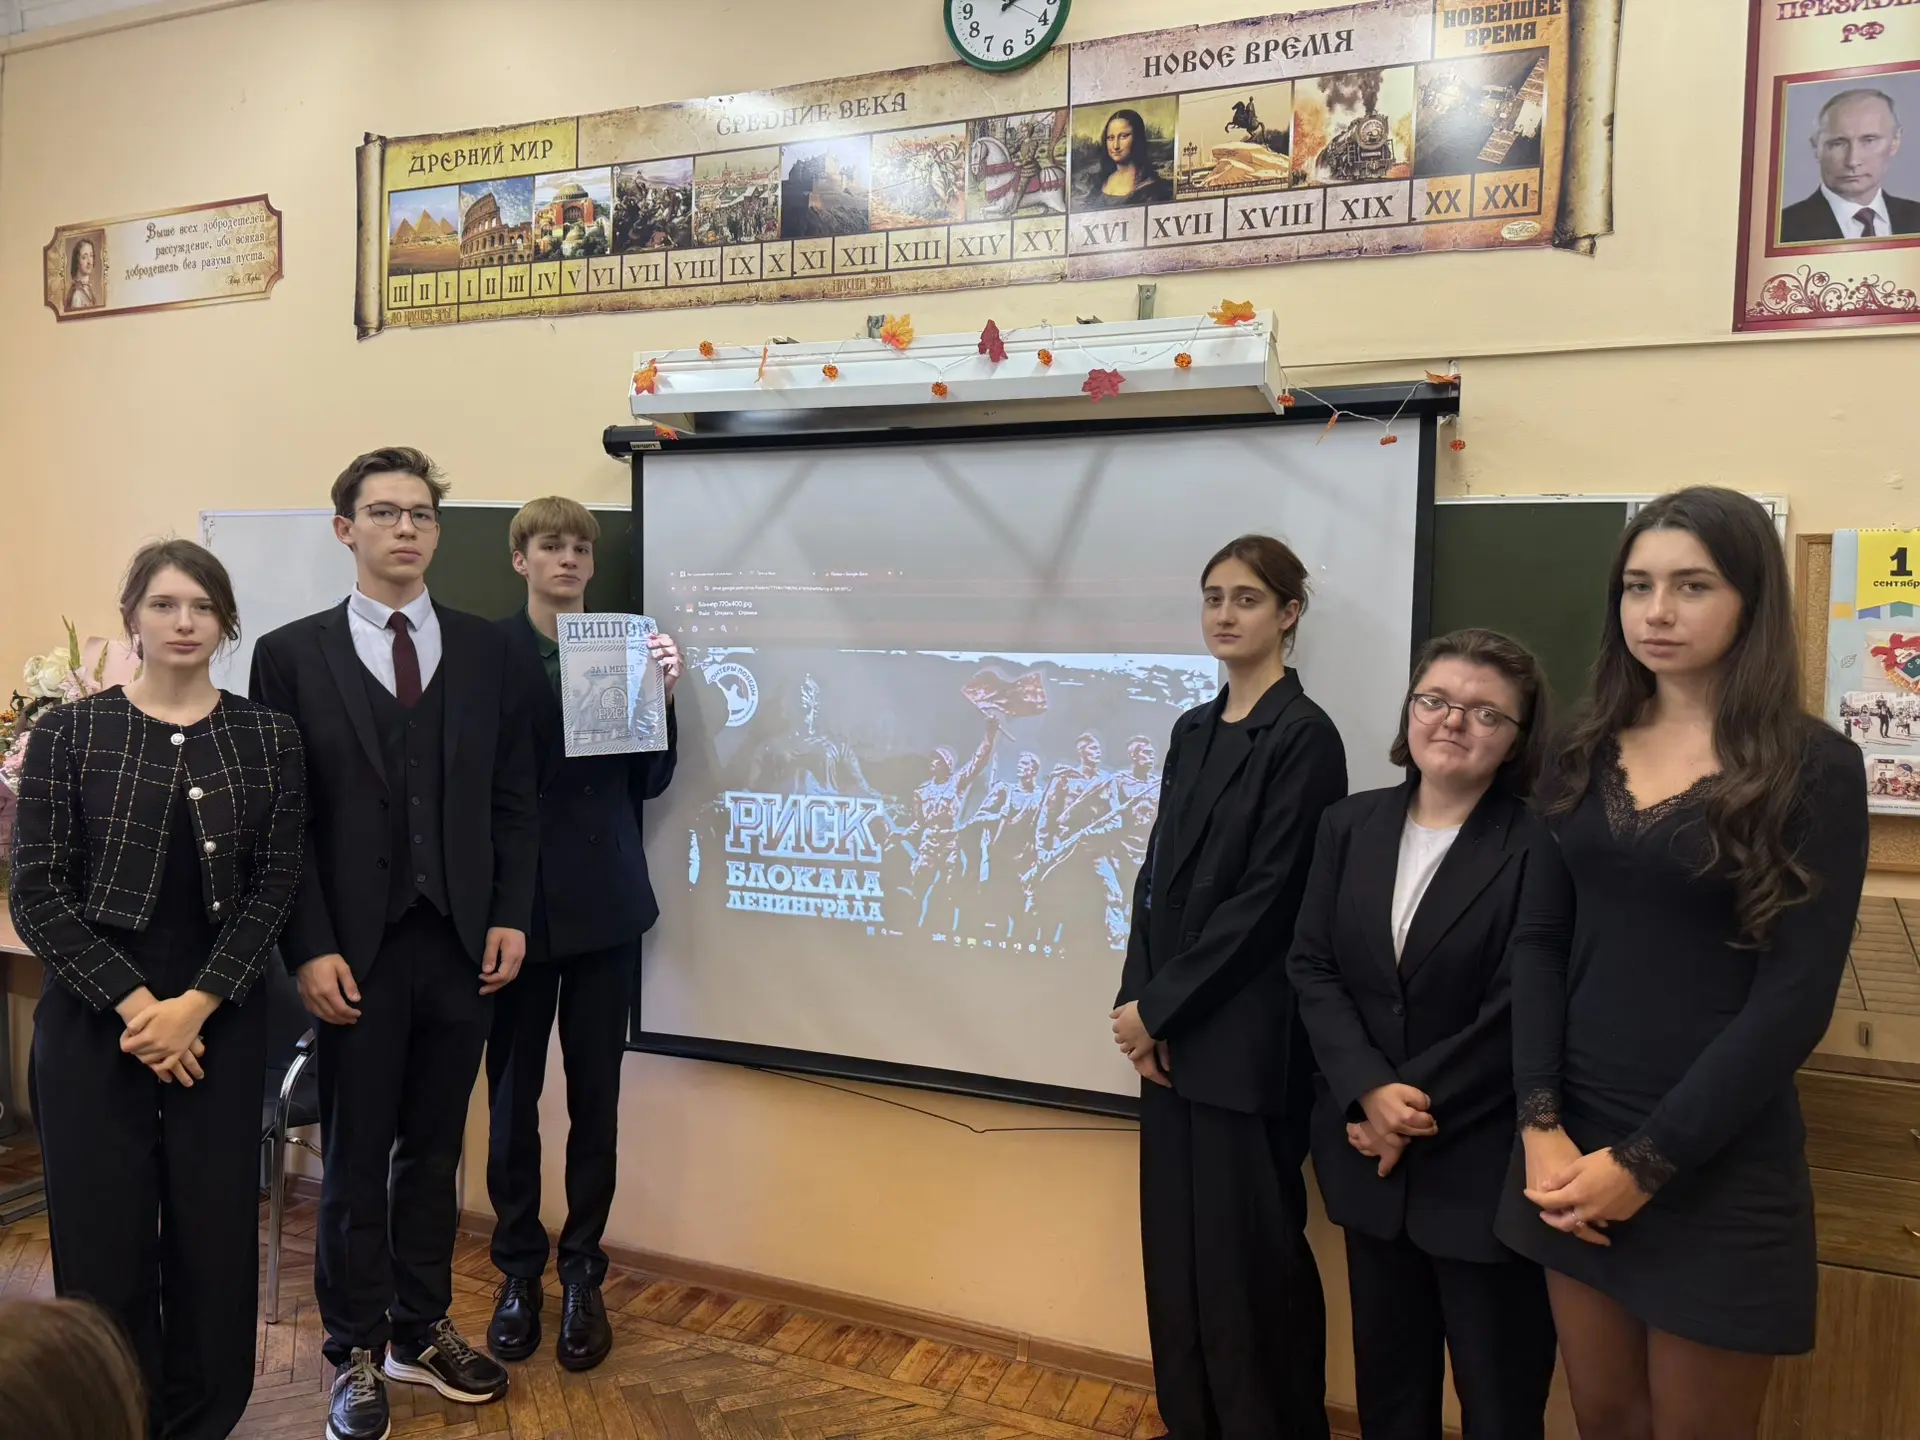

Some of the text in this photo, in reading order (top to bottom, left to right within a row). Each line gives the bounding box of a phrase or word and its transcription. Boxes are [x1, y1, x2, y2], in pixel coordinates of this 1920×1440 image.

[962, 3, 973, 20] 9
[1038, 8, 1049, 26] 4
[969, 21, 980, 38] 8
[1024, 28, 1035, 46] 5
[1465, 21, 1537, 47] ВРЕМЯ
[1840, 21, 1885, 43] РФ
[984, 35, 994, 53] 7
[1003, 39, 1014, 56] 6
[1142, 29, 1354, 78] НОВОЕ ВРЕМЯ
[838, 92, 908, 120] ВЕКА
[408, 139, 554, 177] ДРЕВНИЙ МИР
[145, 212, 265, 243] Выше всех добродетелей
[216, 235, 231, 248] ибо
[235, 232, 265, 245] всякая
[393, 183, 1528, 303] III II I I II III IV V VI VII VIII IX X XI XII XIII XIV XV XVI XVII XVIII XIX XX XXI
[125, 262, 179, 281] добродетель
[183, 258, 197, 270] без
[201, 255, 231, 271] разума
[1889, 547, 1913, 577] 1
[566, 621, 650, 641] ДИПЛОМ
[725, 790, 884, 864] РИСК
[726, 860, 884, 899] БЛОКАДА
[726, 890, 884, 922] ЛЕНИНГРАДА
